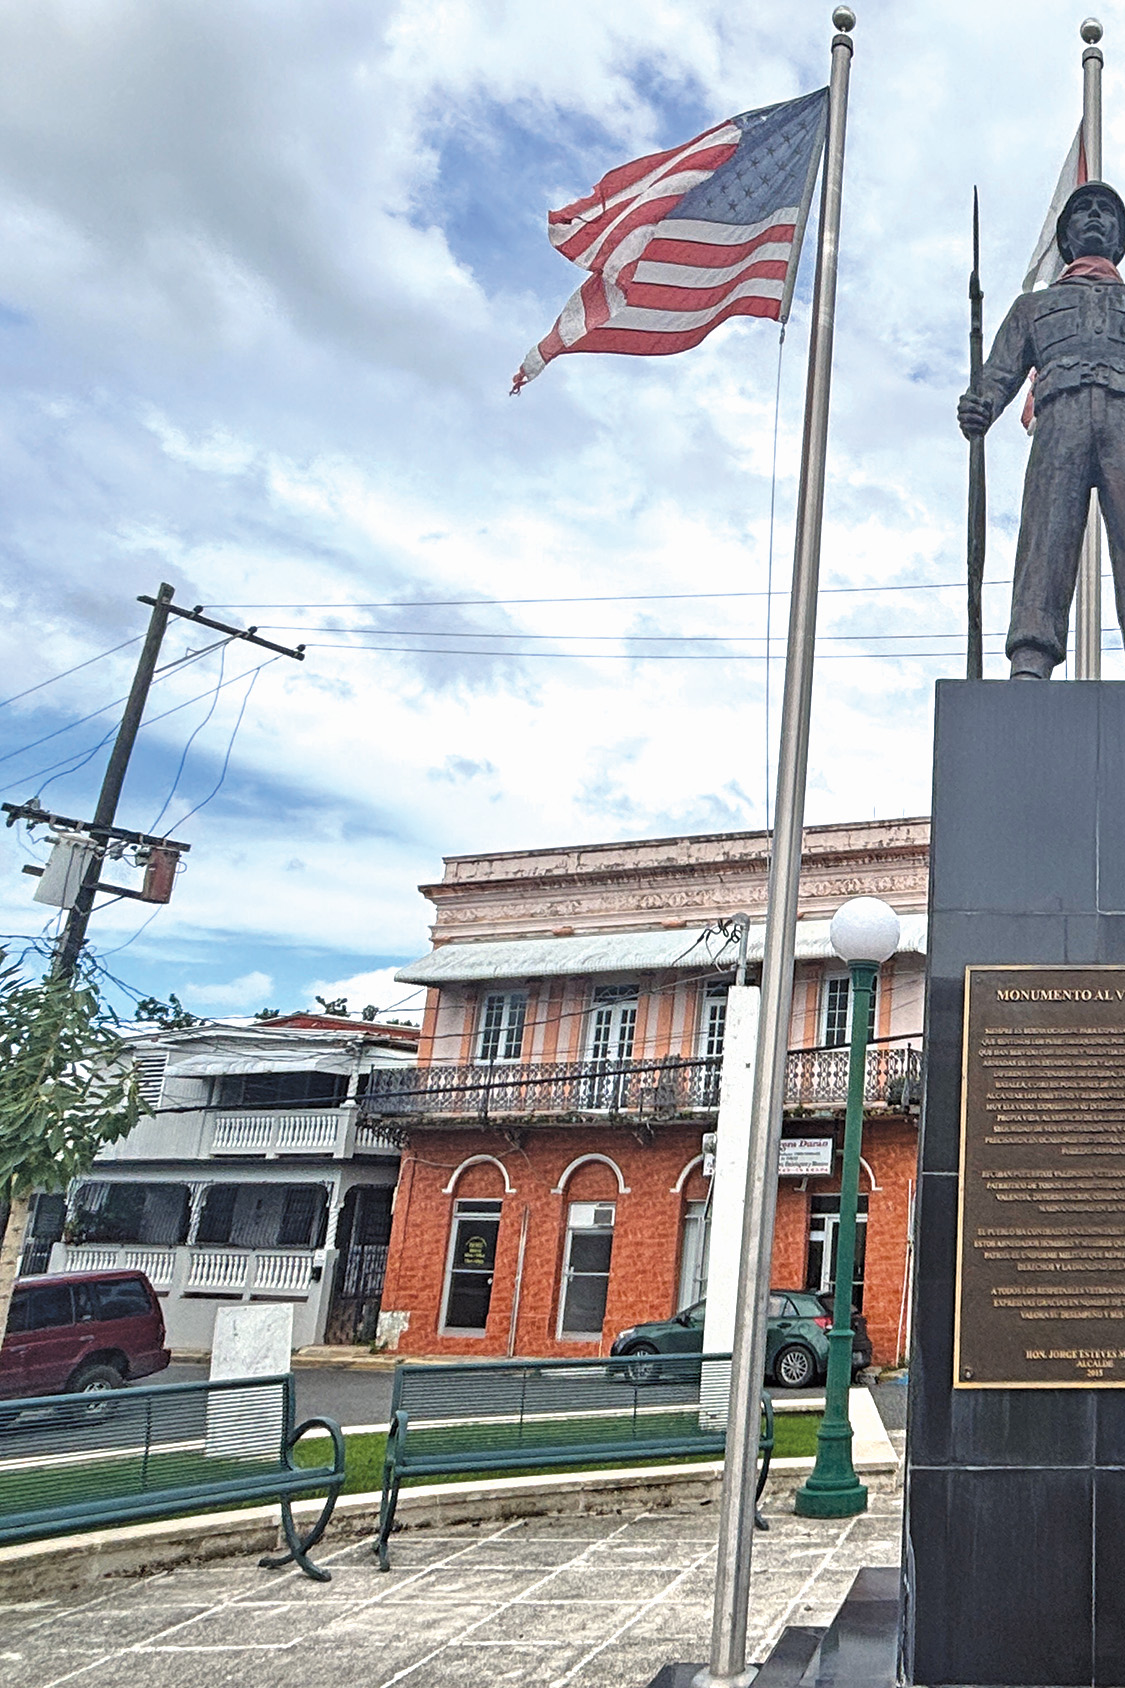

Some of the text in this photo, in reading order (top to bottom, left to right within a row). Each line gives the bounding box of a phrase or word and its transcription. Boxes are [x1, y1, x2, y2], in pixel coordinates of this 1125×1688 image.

[996, 989, 1092, 1002] MONUMENTO
[1095, 989, 1113, 1002] AL
[1048, 1350, 1078, 1359] JORGE
[1076, 1360, 1114, 1368] ALCALDE
